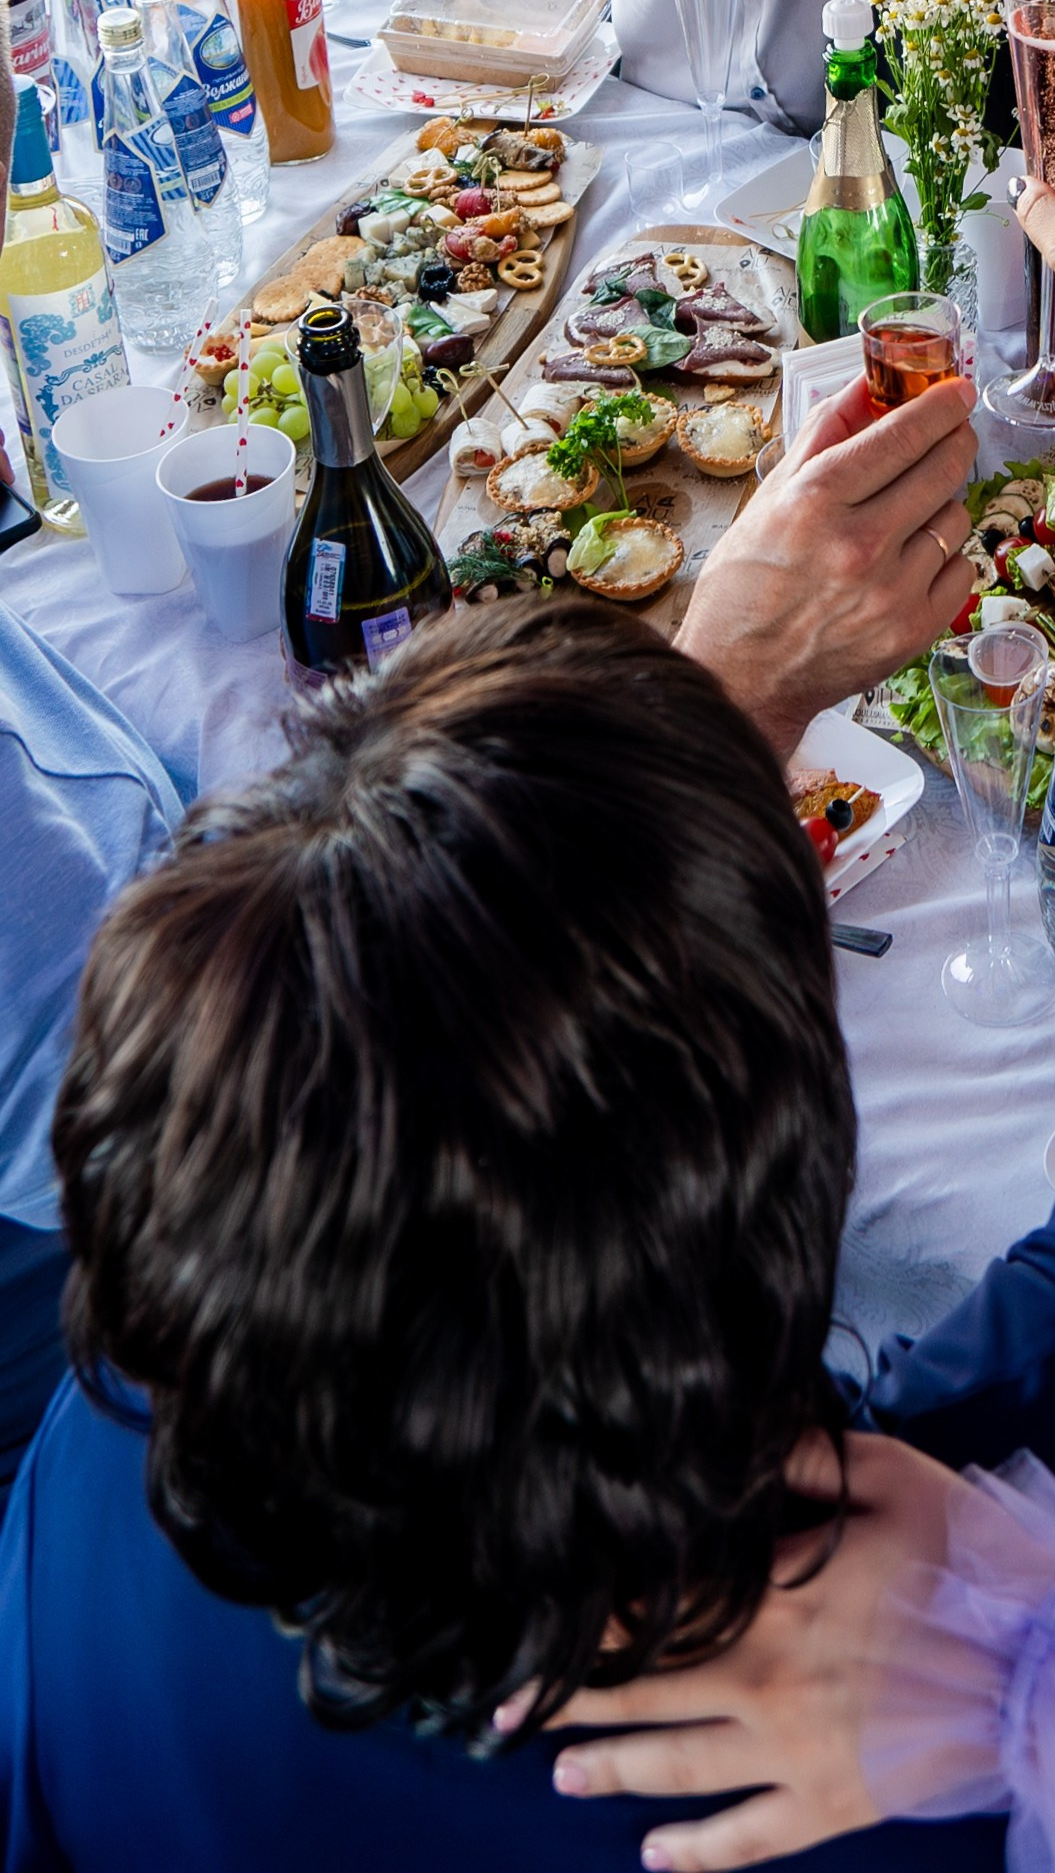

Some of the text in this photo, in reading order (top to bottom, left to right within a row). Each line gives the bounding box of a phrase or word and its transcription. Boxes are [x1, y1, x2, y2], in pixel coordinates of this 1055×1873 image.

[13, 42, 49, 67] arin
[72, 363, 118, 392] CASAL
[61, 393, 83, 406] DA
